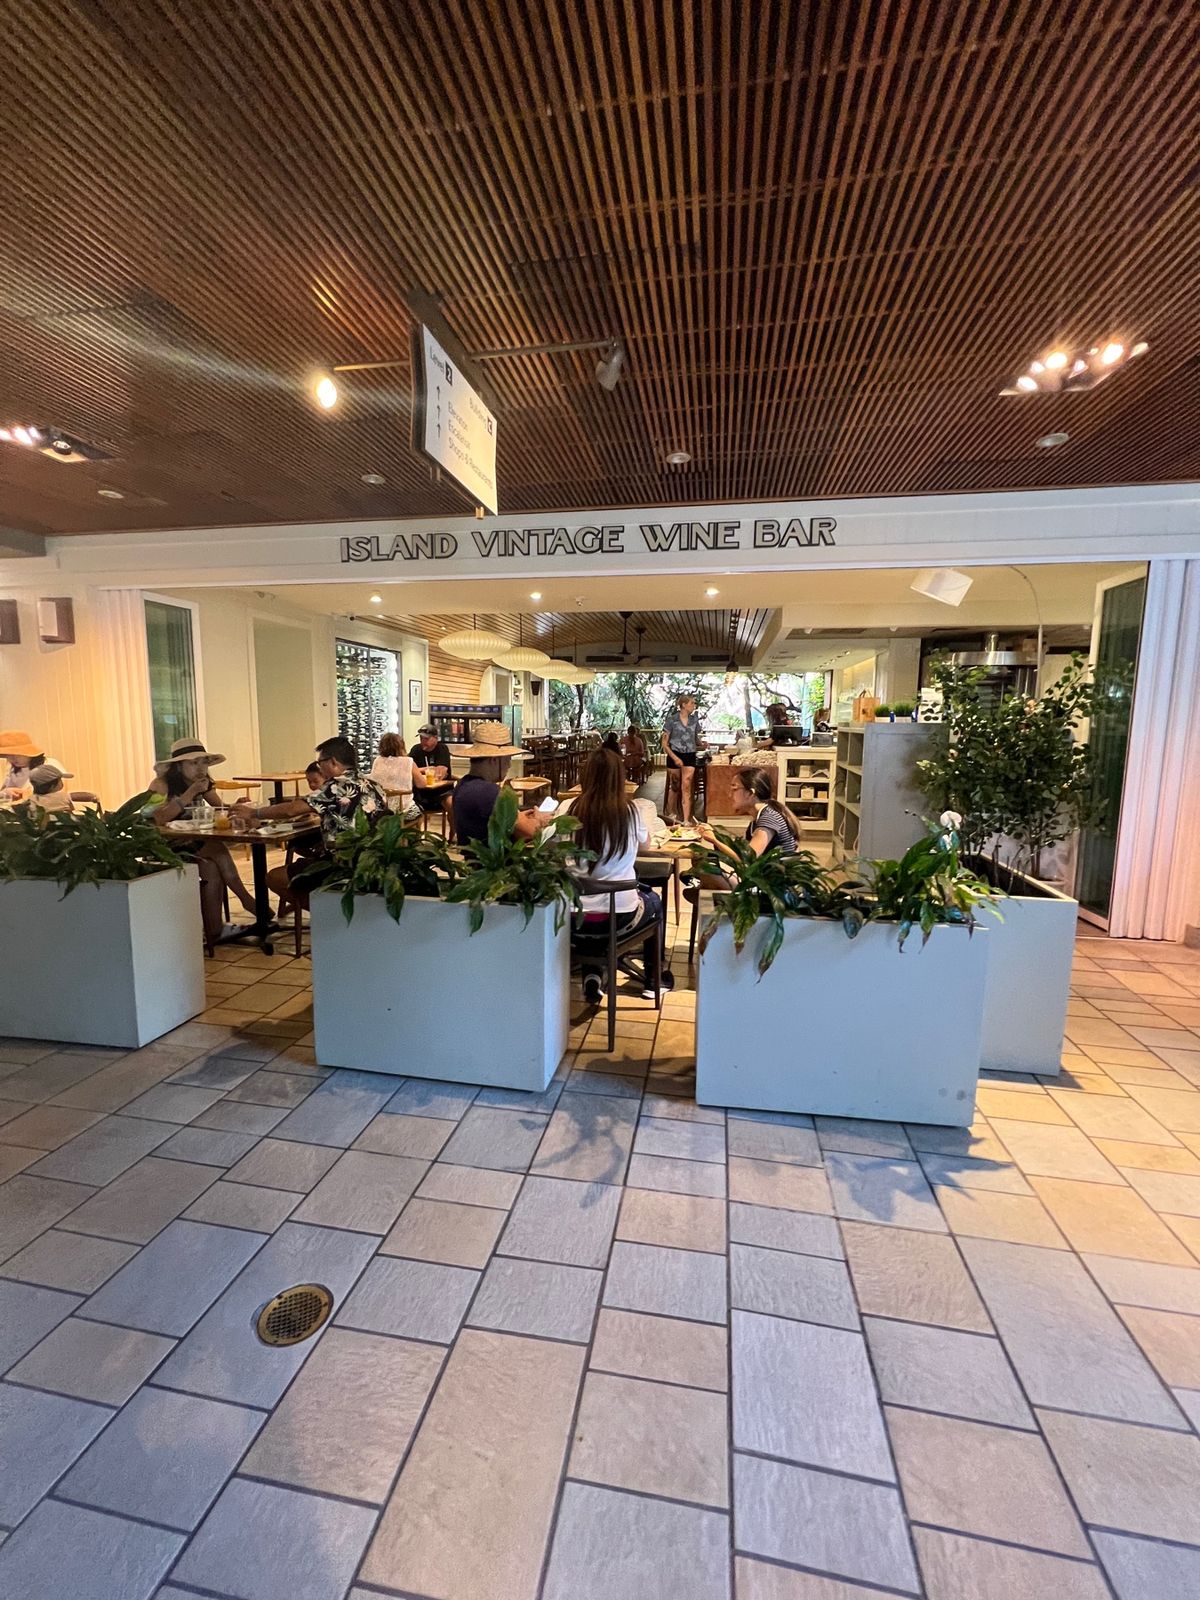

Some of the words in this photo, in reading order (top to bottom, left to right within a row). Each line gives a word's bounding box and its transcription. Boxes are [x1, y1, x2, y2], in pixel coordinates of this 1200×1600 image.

[340, 532, 458, 563] ISLAND
[471, 525, 624, 558] VINTAGE
[639, 521, 740, 551] WINE
[754, 517, 837, 549] BAR
